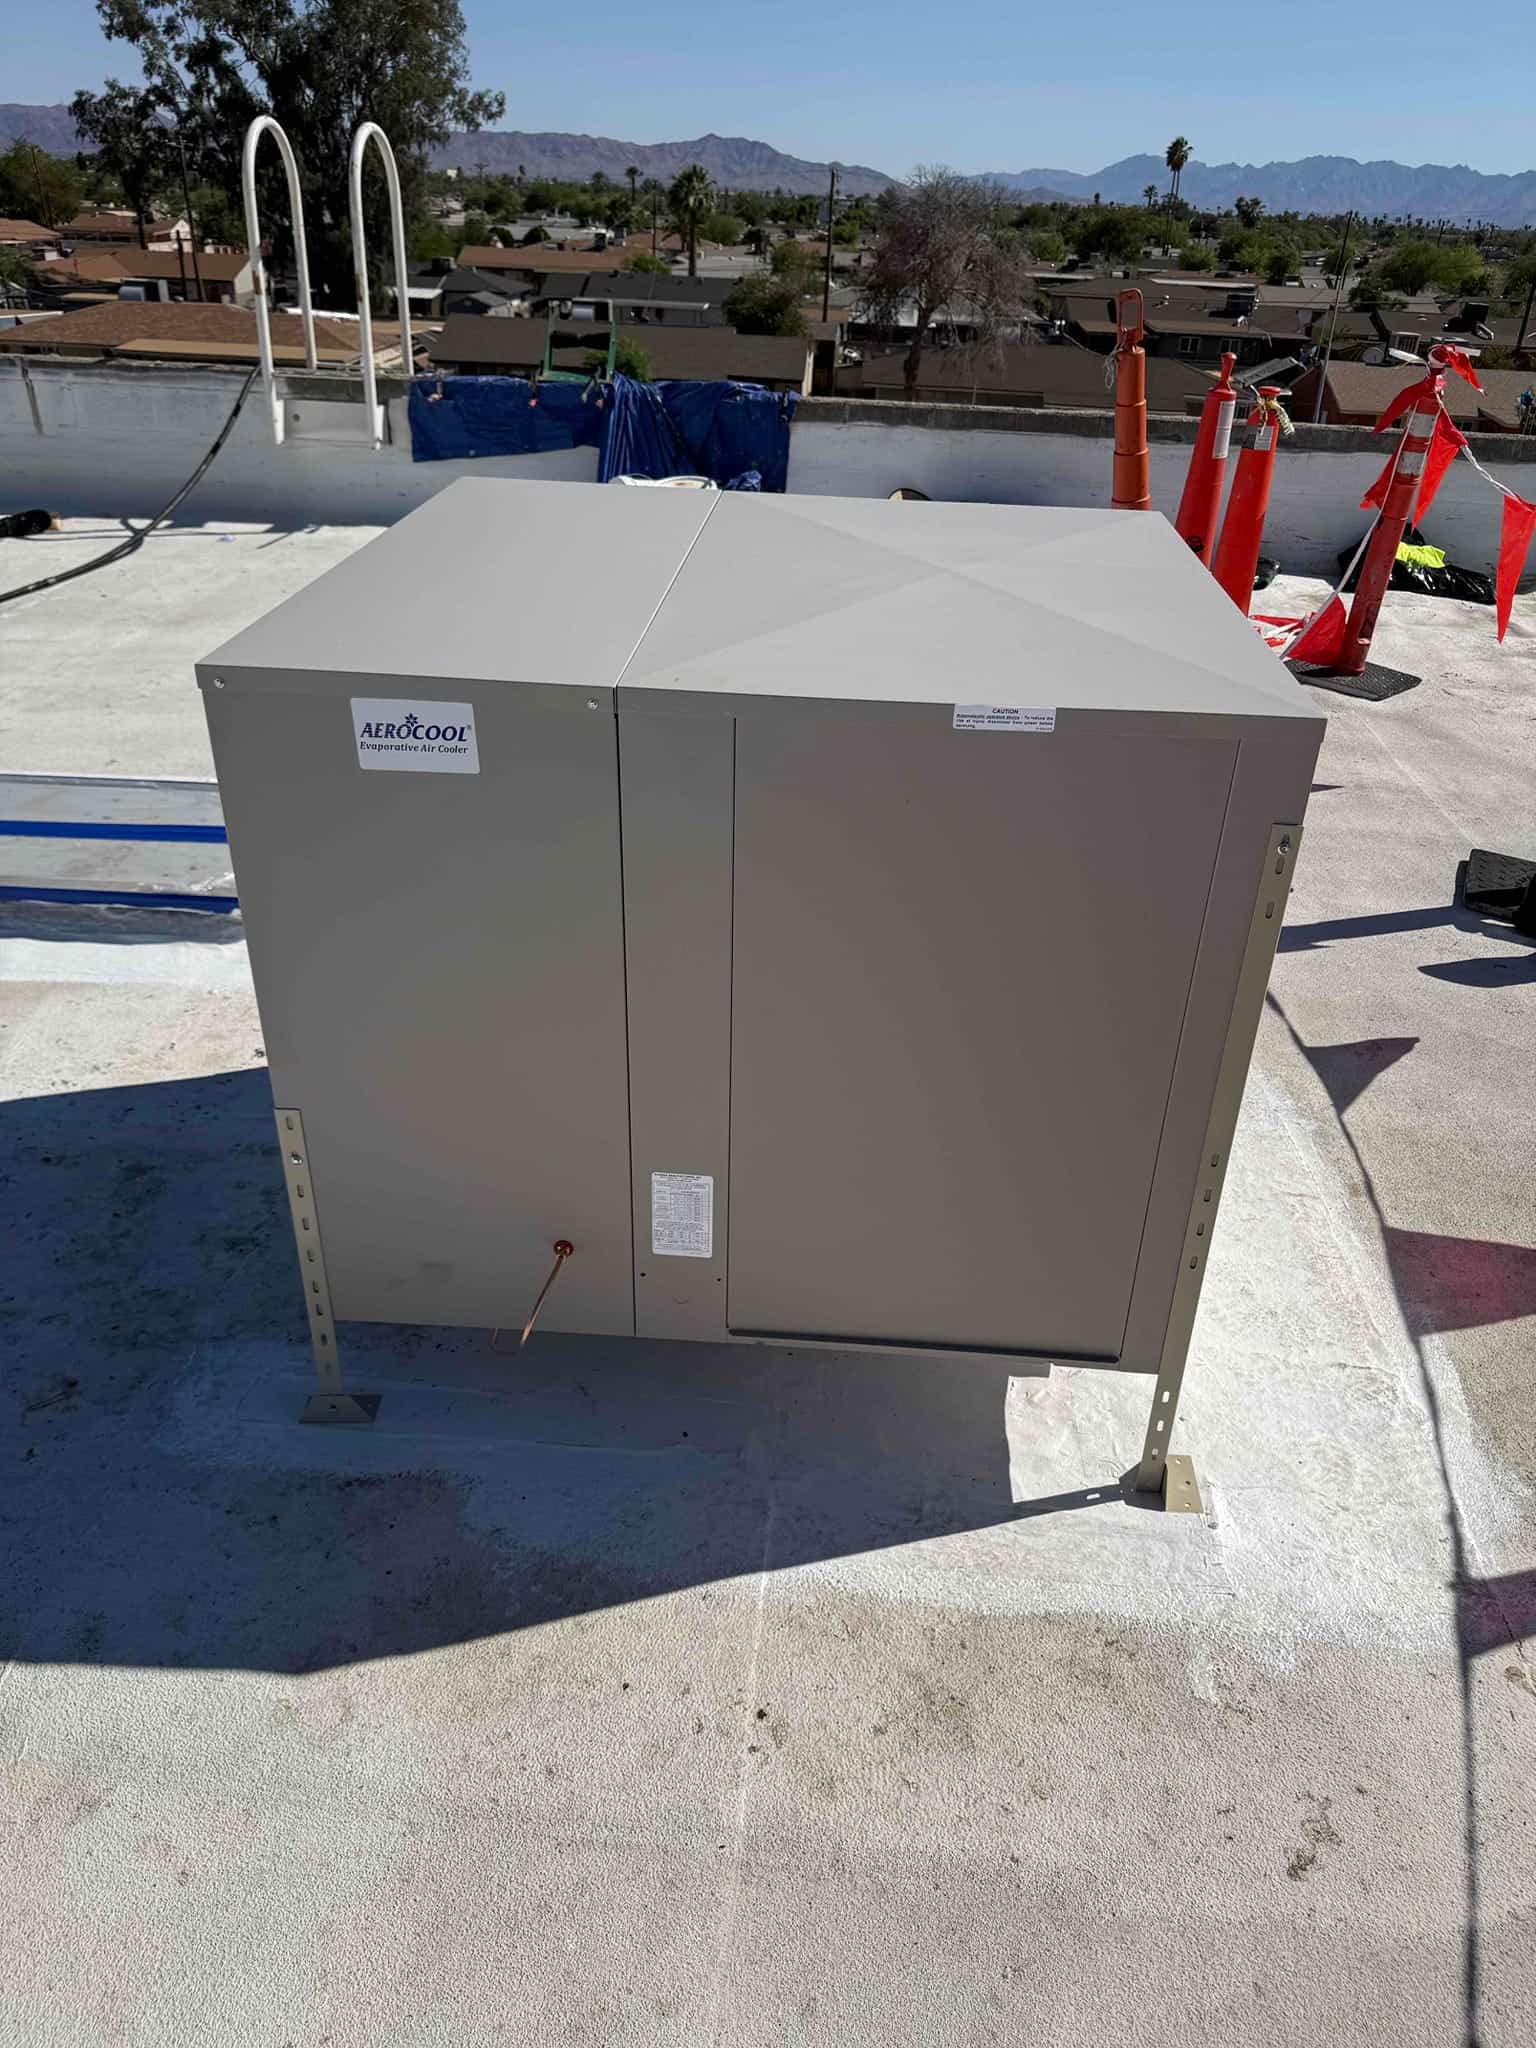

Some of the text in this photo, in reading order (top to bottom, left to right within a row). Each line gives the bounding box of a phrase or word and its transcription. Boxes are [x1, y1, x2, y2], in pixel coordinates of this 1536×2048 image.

[360, 722, 468, 742] AEROCOOL
[360, 741, 469, 754] Evaporative Air Cooler
